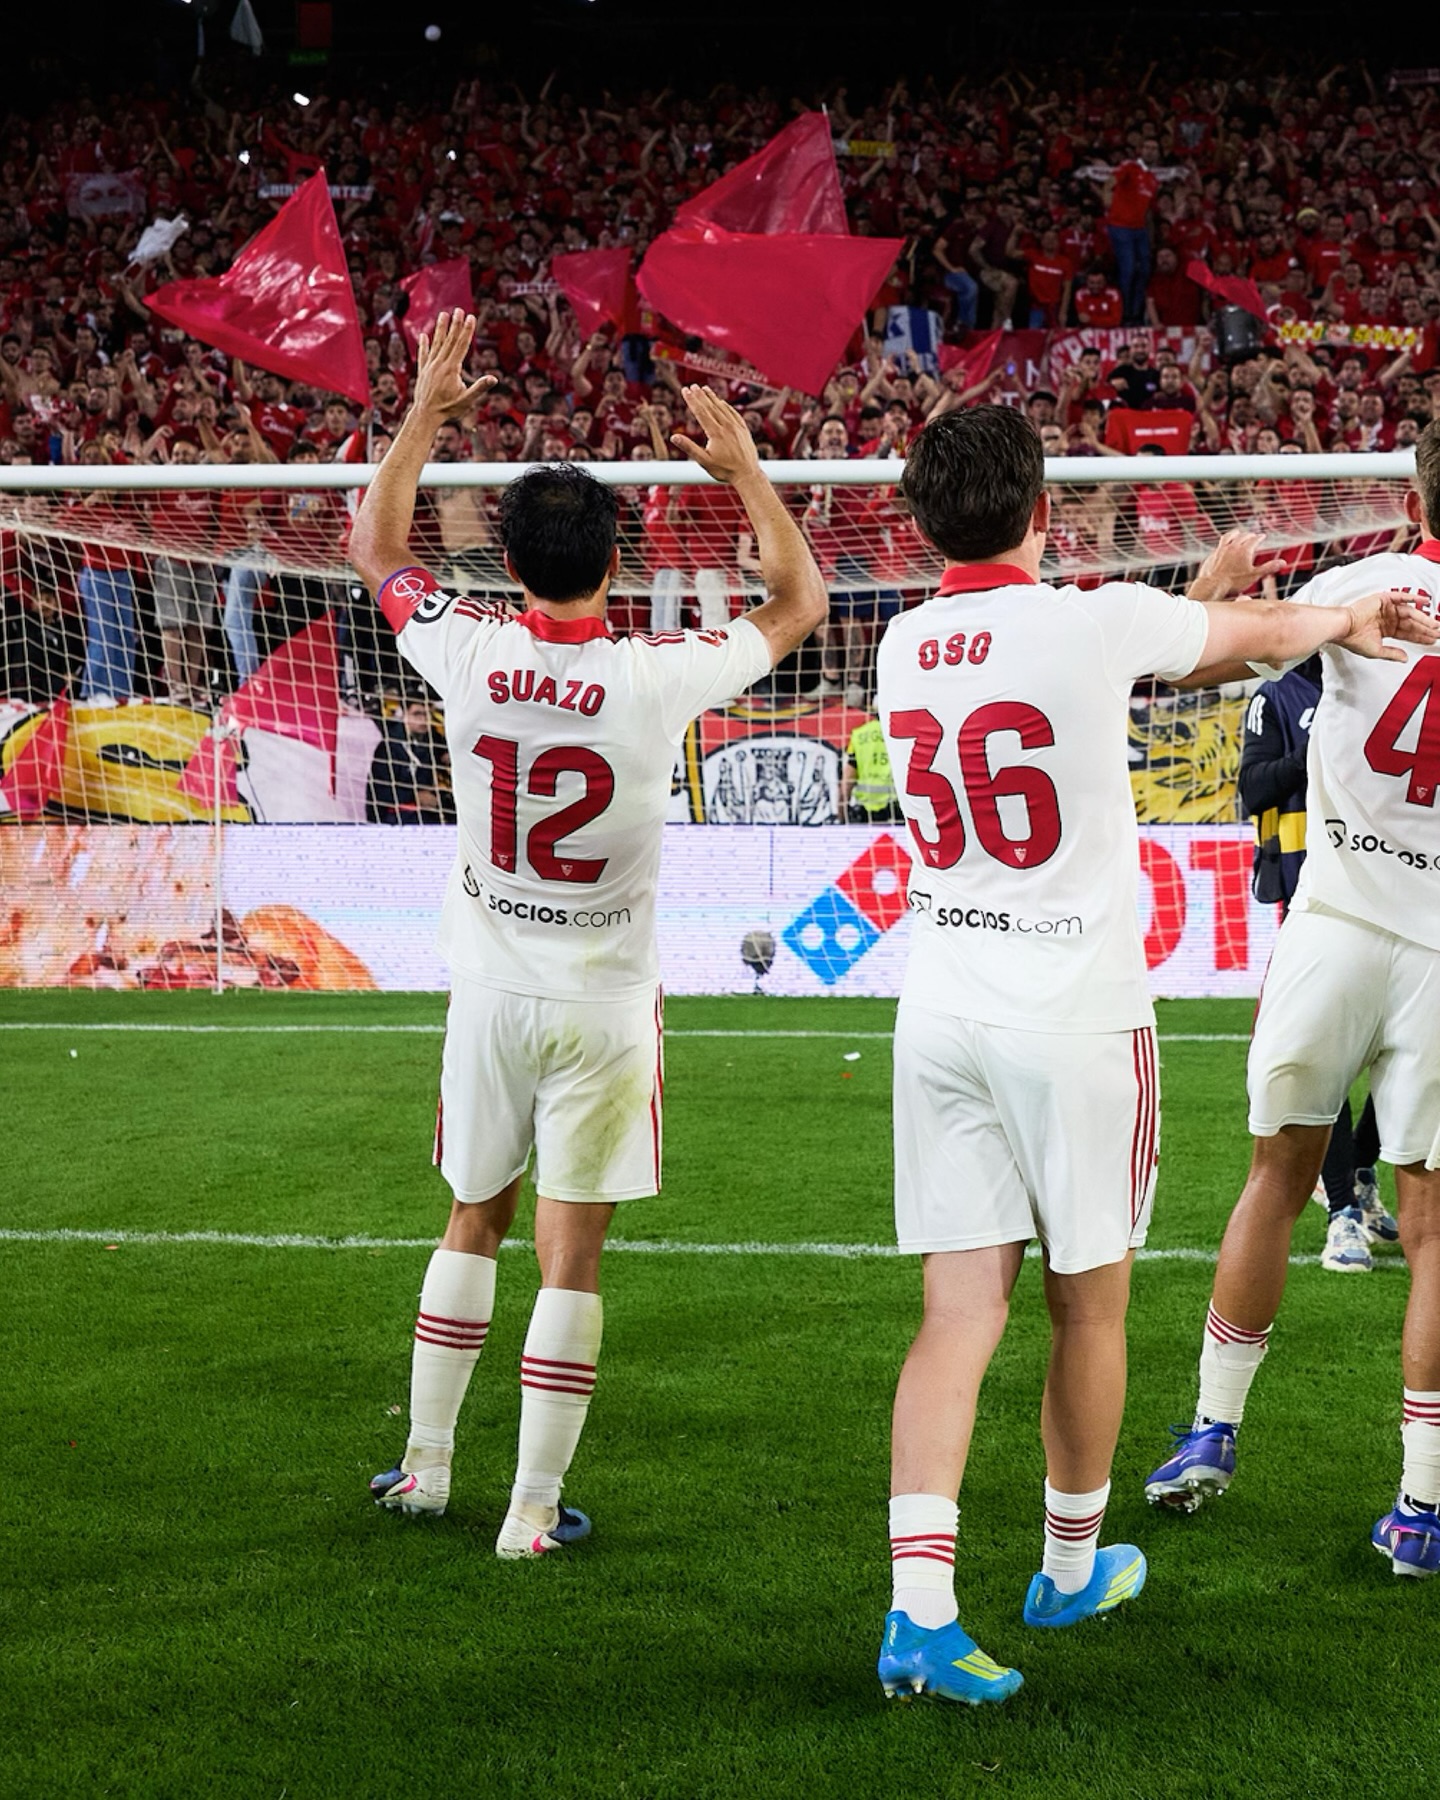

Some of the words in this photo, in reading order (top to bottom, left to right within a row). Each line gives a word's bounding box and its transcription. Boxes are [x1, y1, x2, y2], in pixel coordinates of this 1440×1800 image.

[487, 669, 606, 717] SUAZO
[918, 631, 993, 670] OSO
[888, 700, 1062, 871] 36
[1364, 655, 1440, 808] 4
[471, 734, 615, 883] 12
